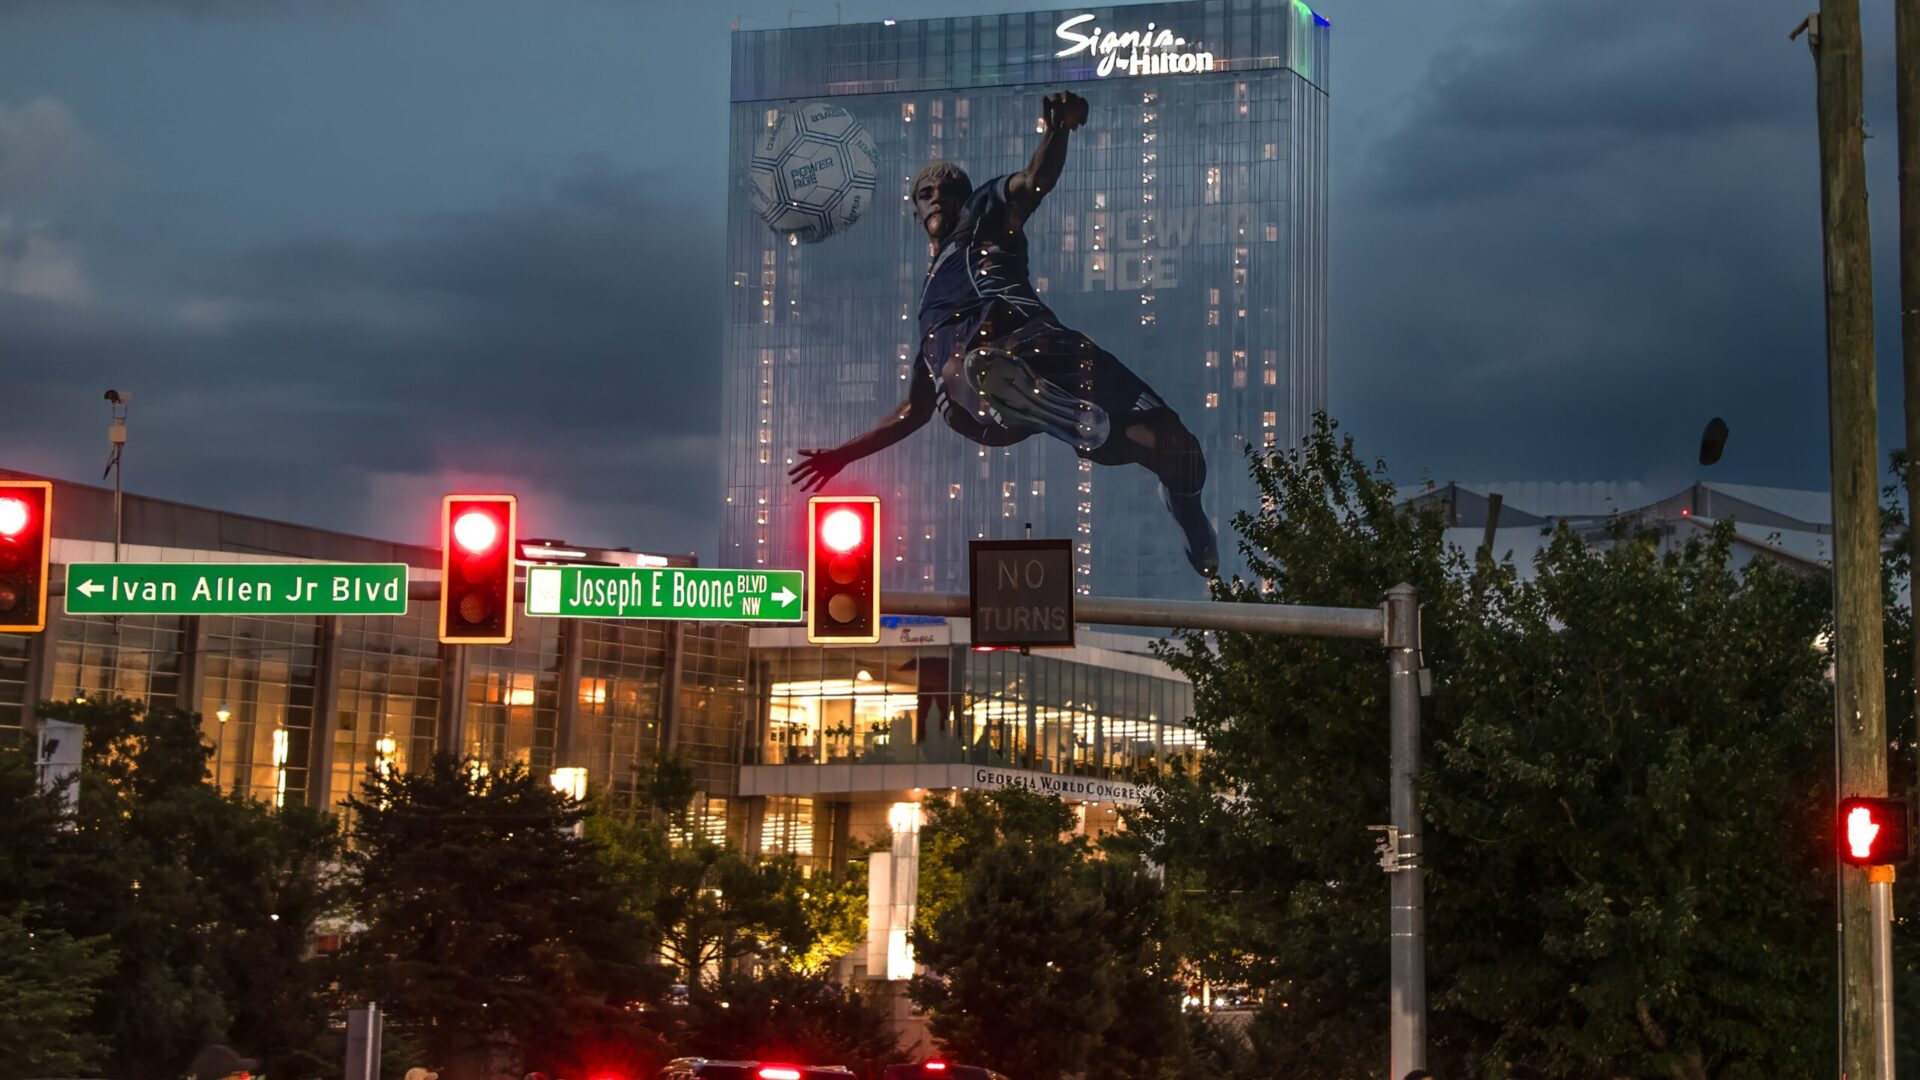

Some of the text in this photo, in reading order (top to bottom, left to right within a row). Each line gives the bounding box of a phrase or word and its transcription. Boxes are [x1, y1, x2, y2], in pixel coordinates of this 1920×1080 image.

[1055, 13, 1186, 77] Signia
[1129, 50, 1214, 76] Hilton
[737, 575, 768, 594] BLVD
[997, 559, 1045, 590] NO
[112, 576, 399, 602] Ivan Allen Jr Blvd
[569, 571, 734, 616] Joseph E Boone
[742, 597, 761, 616] NW
[979, 606, 1067, 632] TURNS
[976, 769, 1036, 790] GEORGIA
[1040, 776, 1084, 793] WORLD
